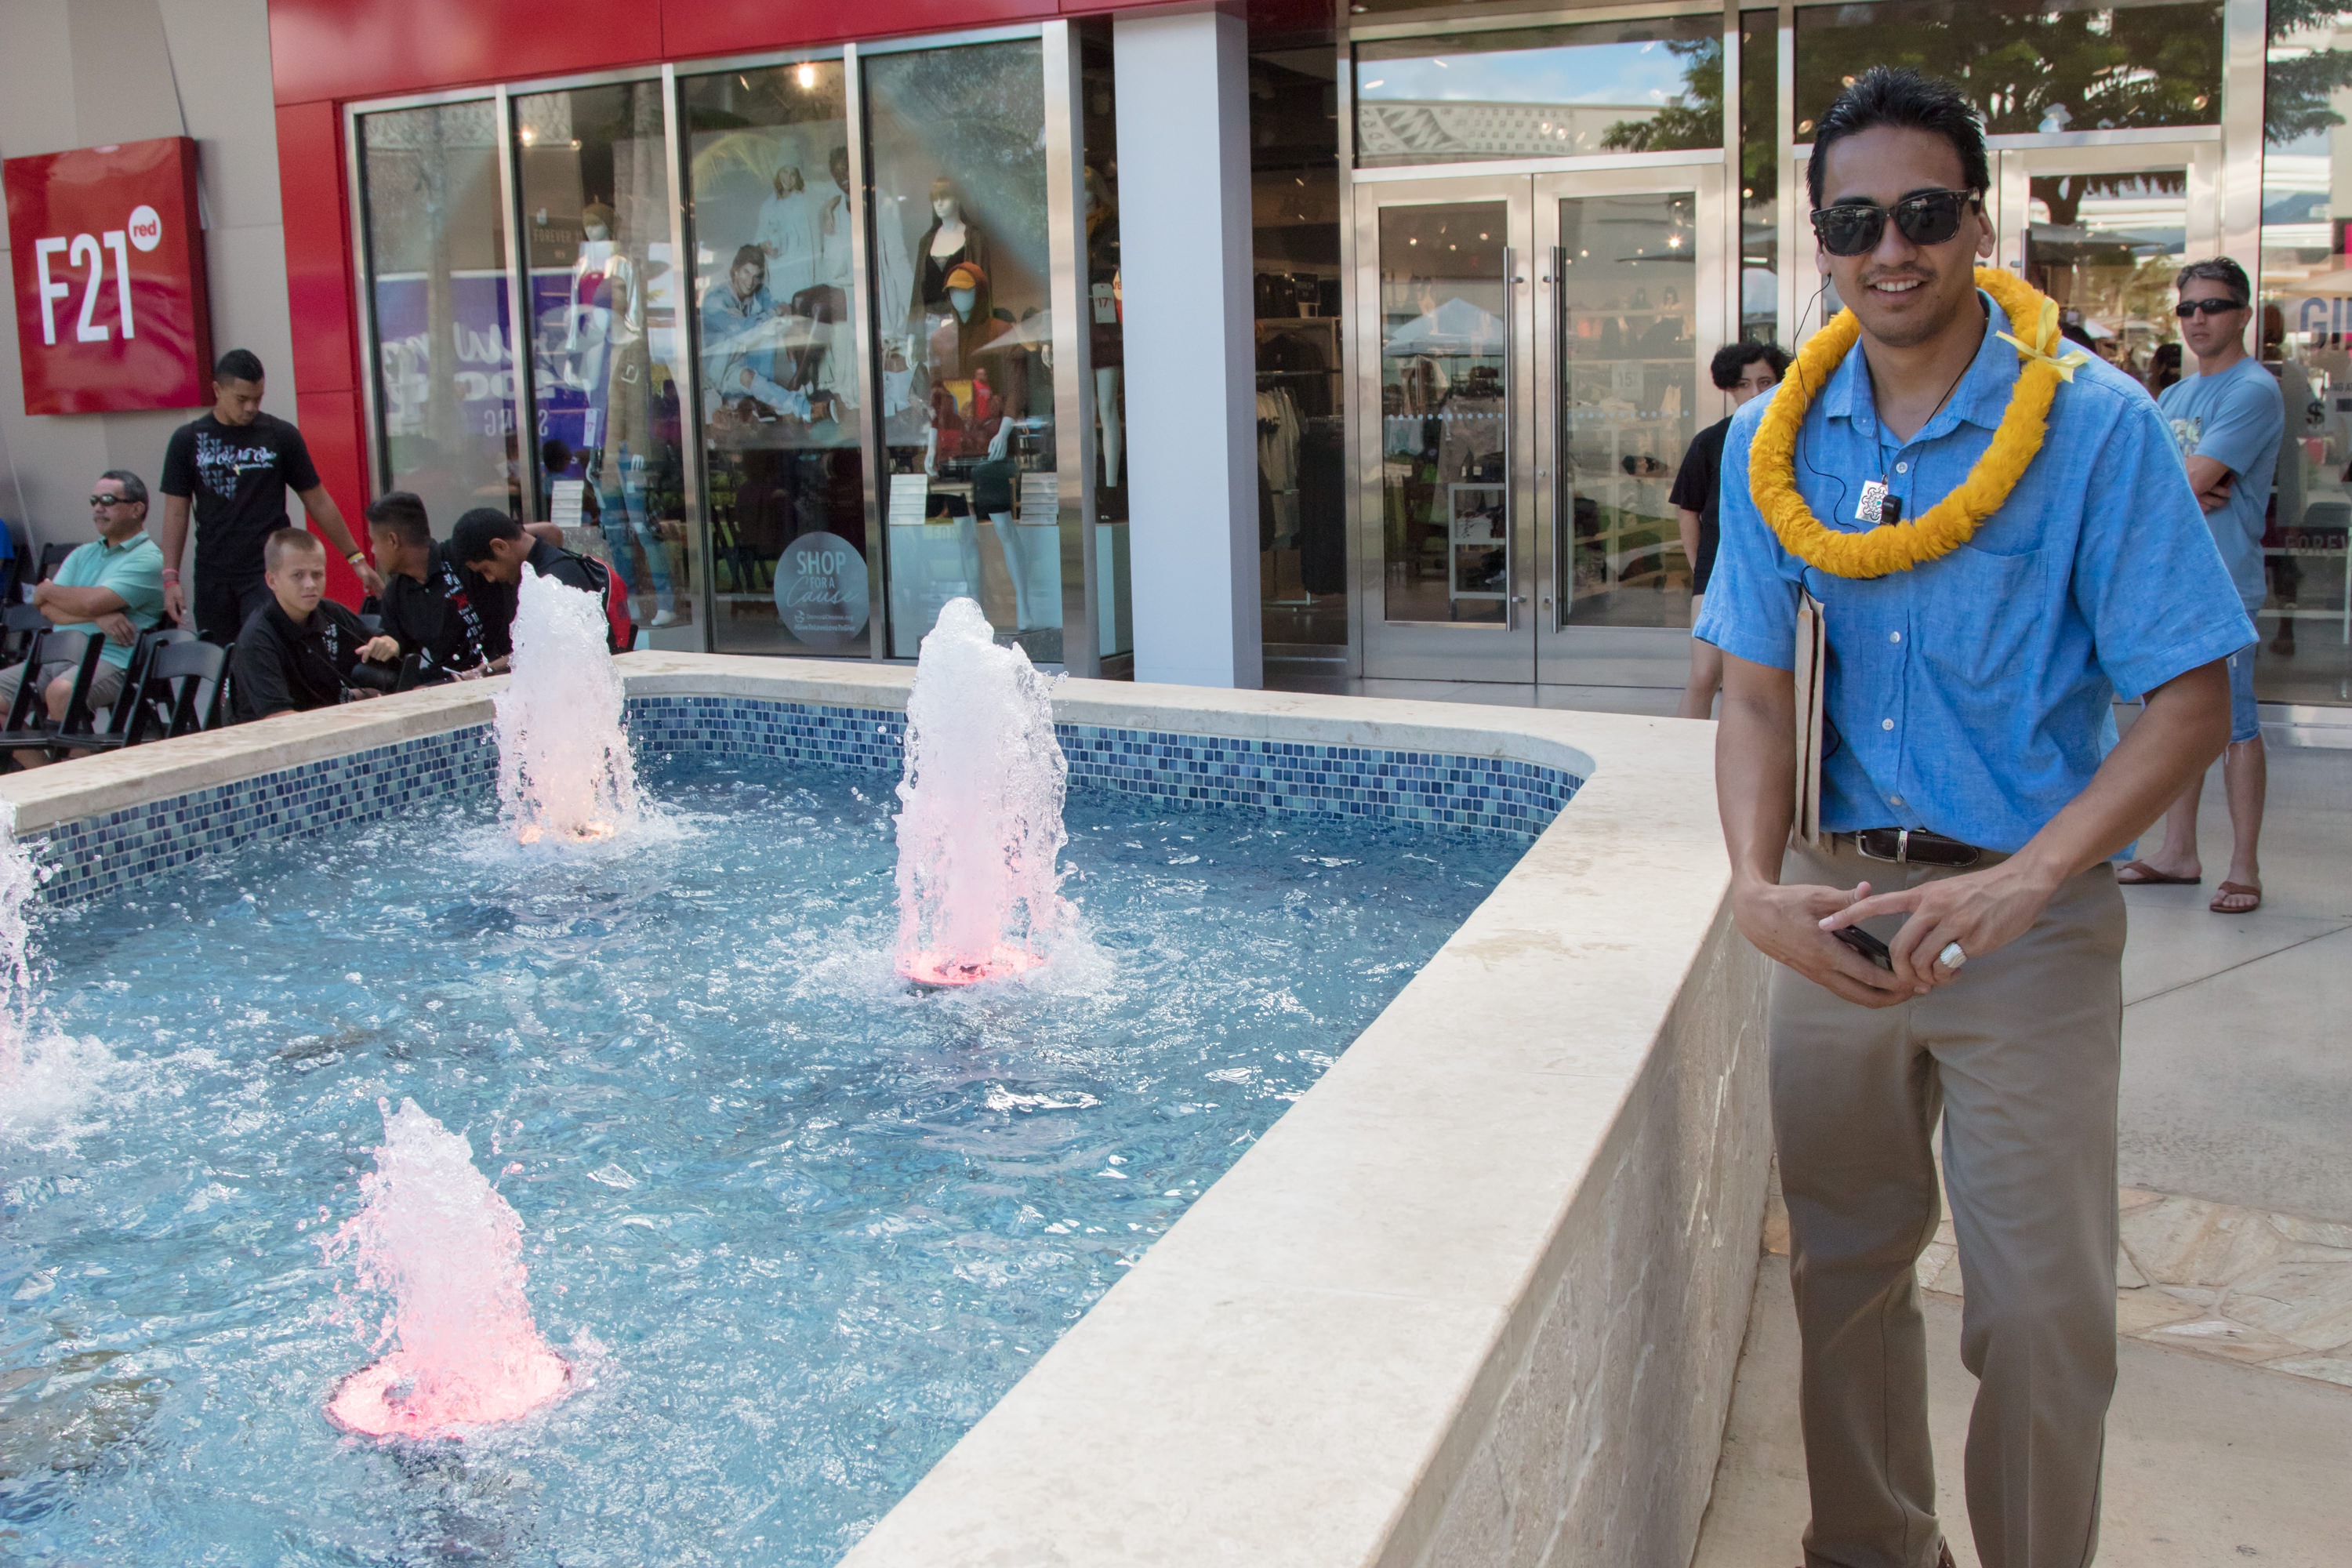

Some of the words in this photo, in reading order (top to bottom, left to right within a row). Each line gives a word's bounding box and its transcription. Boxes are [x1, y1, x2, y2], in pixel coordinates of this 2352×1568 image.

[132, 220, 157, 238] red
[35, 230, 135, 346] F21
[796, 550, 847, 575] SHOP
[786, 575, 860, 608] Cause
[809, 576, 828, 590] FOR
[829, 576, 835, 589] A
